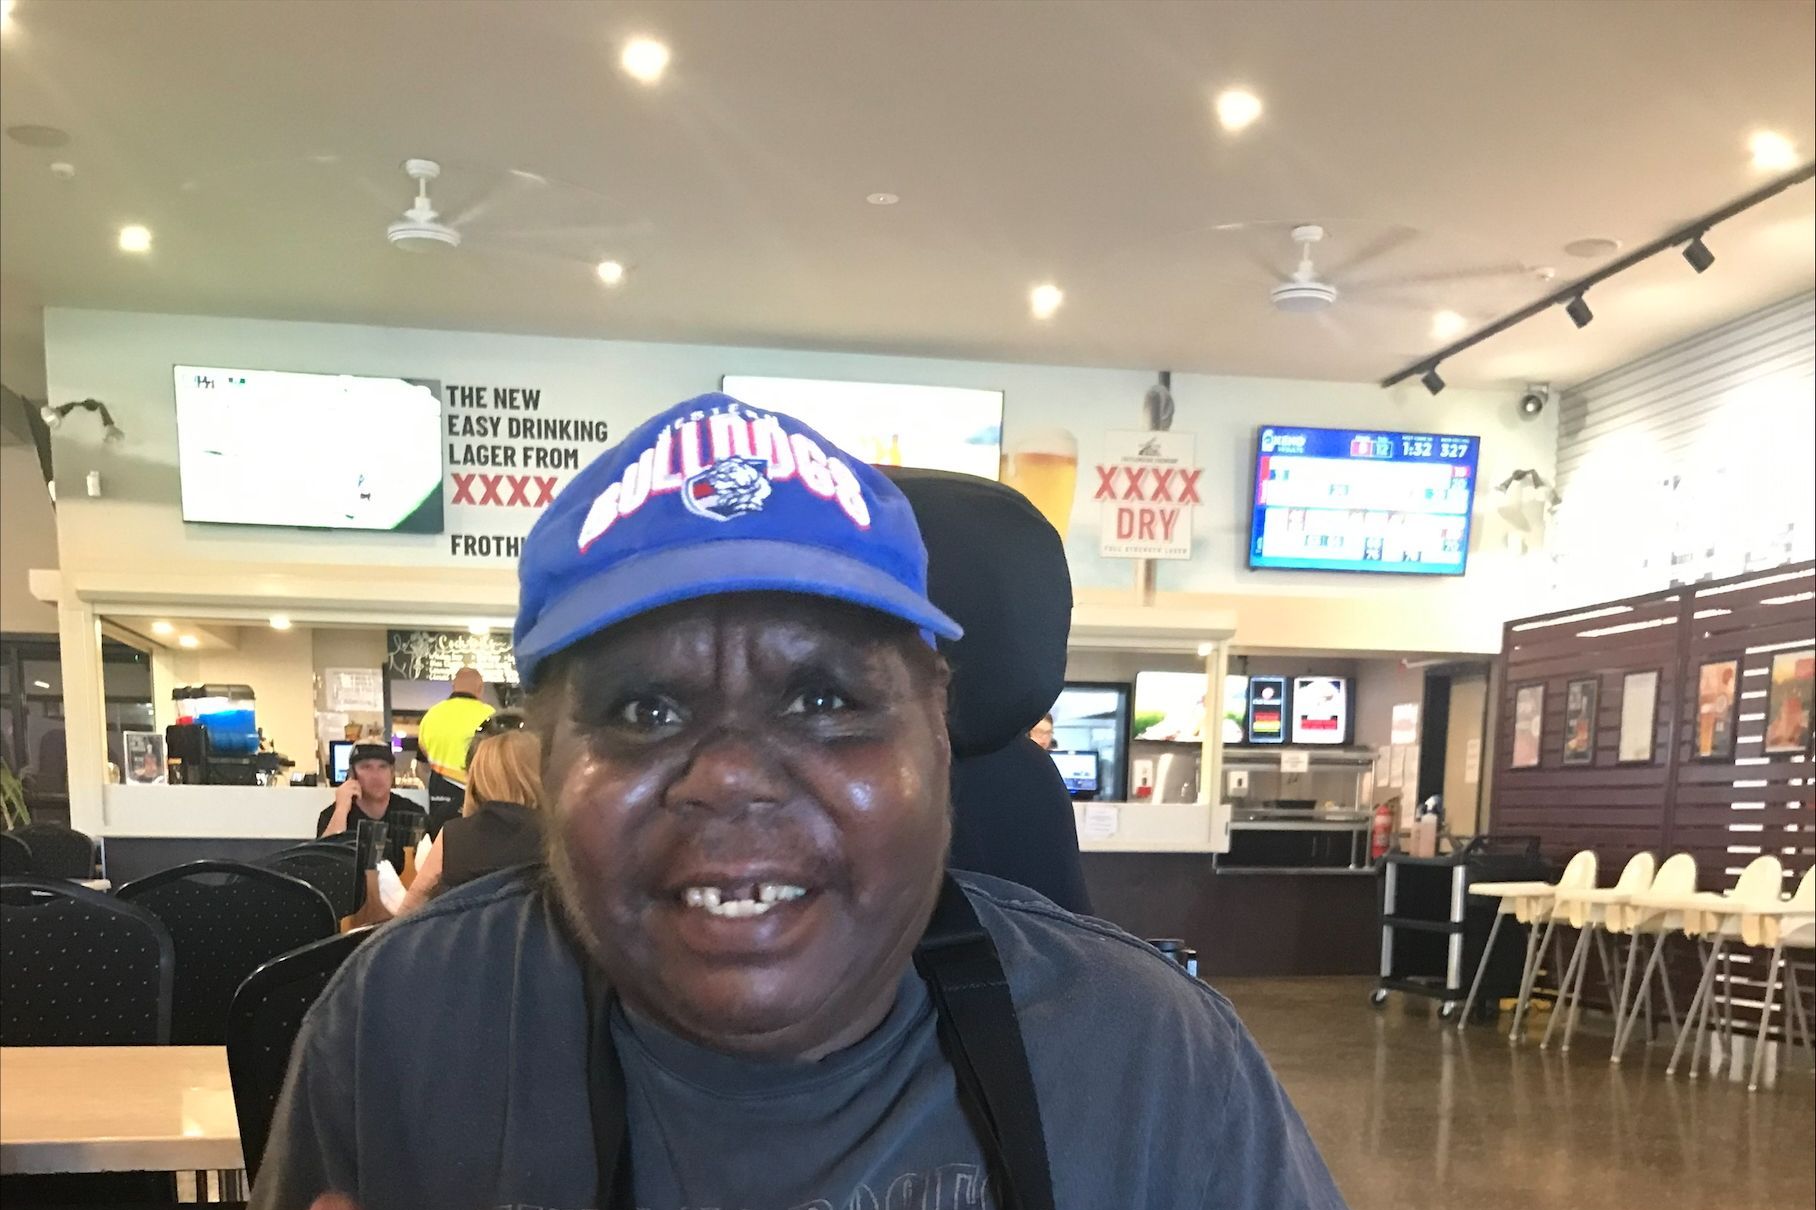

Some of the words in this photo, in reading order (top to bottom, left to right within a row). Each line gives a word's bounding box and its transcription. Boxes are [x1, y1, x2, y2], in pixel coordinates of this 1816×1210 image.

[446, 386, 487, 408] THE
[494, 387, 541, 411] NEW
[448, 415, 501, 438] EASY
[508, 418, 608, 443] DRINKING
[449, 443, 516, 467] LAGER
[523, 447, 579, 470] FROM
[1403, 442, 1432, 457] 1:32
[1440, 443, 1468, 458] 327
[451, 473, 559, 508] XXXX
[1094, 465, 1204, 504] XXXX
[1117, 507, 1177, 541] DRY
